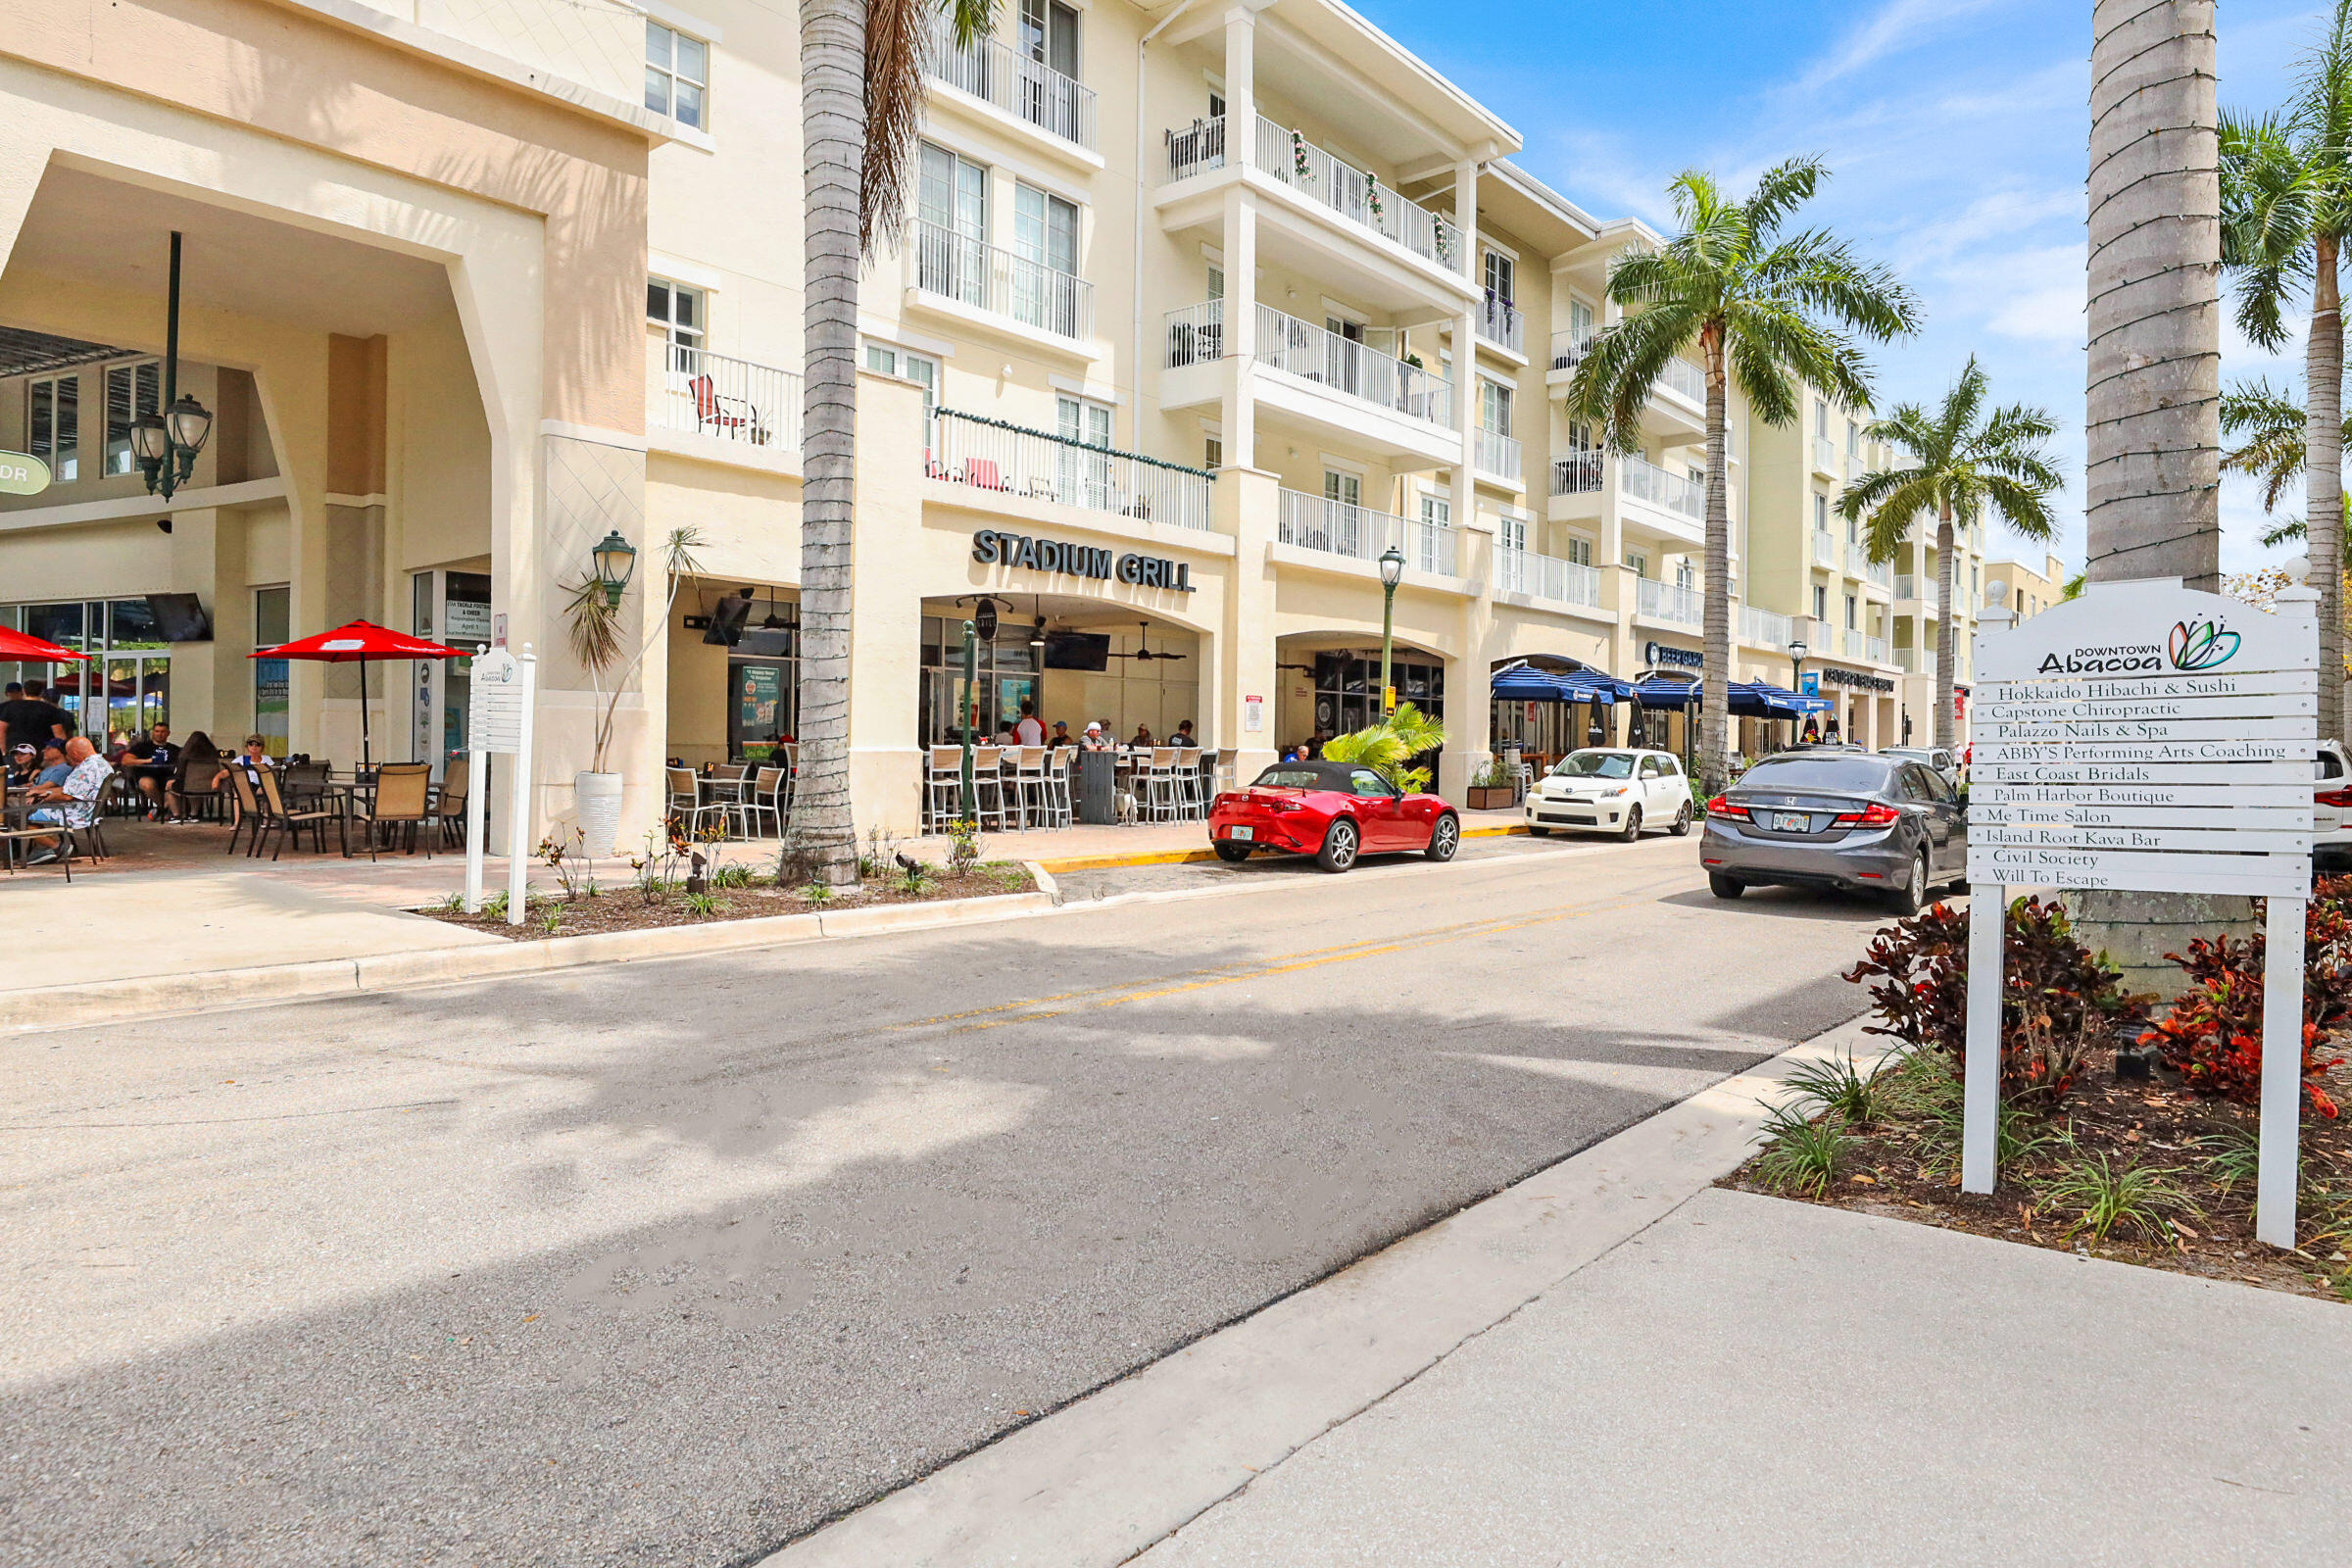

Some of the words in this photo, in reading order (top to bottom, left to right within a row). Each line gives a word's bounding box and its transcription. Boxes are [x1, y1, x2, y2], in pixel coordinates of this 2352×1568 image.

[972, 529, 1113, 580] STADIUM
[1115, 553, 1197, 593] GRILL
[1661, 647, 1682, 663] BEER
[2075, 645, 2161, 658] DOWNTOWN
[2036, 653, 2162, 673] Abacoa
[1999, 685, 2082, 701] Hokkaido
[2087, 682, 2157, 698] Hibachi
[2164, 682, 2180, 694] &
[2186, 678, 2236, 693] Sushi
[1991, 706, 2067, 720] Capstone
[2072, 703, 2180, 718] Chiropractic
[1999, 724, 2058, 738] Palazzo
[2064, 723, 2110, 737] Nails
[2116, 724, 2131, 736] &
[2136, 722, 2169, 739] Spa
[1997, 746, 2058, 760] ABBY'S
[2064, 745, 2153, 760] Performing
[2158, 745, 2194, 759] Arts
[2200, 743, 2285, 759] Coaching
[1996, 767, 2029, 780] East
[2035, 766, 2080, 780] Coast
[2088, 767, 2149, 781] Bridals
[1994, 789, 2031, 802] Palm
[2036, 788, 2092, 802] Harbor
[2099, 789, 2175, 804] Boutique
[1987, 808, 2012, 821] Me
[2017, 809, 2059, 822] Time
[2064, 808, 2111, 823] Salon
[1986, 829, 2033, 843] Island
[2039, 830, 2079, 845] Root
[2084, 831, 2125, 846] Kava
[2132, 832, 2162, 847] Bar
[1993, 849, 2033, 863] Civil
[2038, 851, 2099, 869] Society
[1992, 868, 2025, 882] Will
[2030, 869, 2050, 883] To
[2056, 870, 2109, 889] Escape
